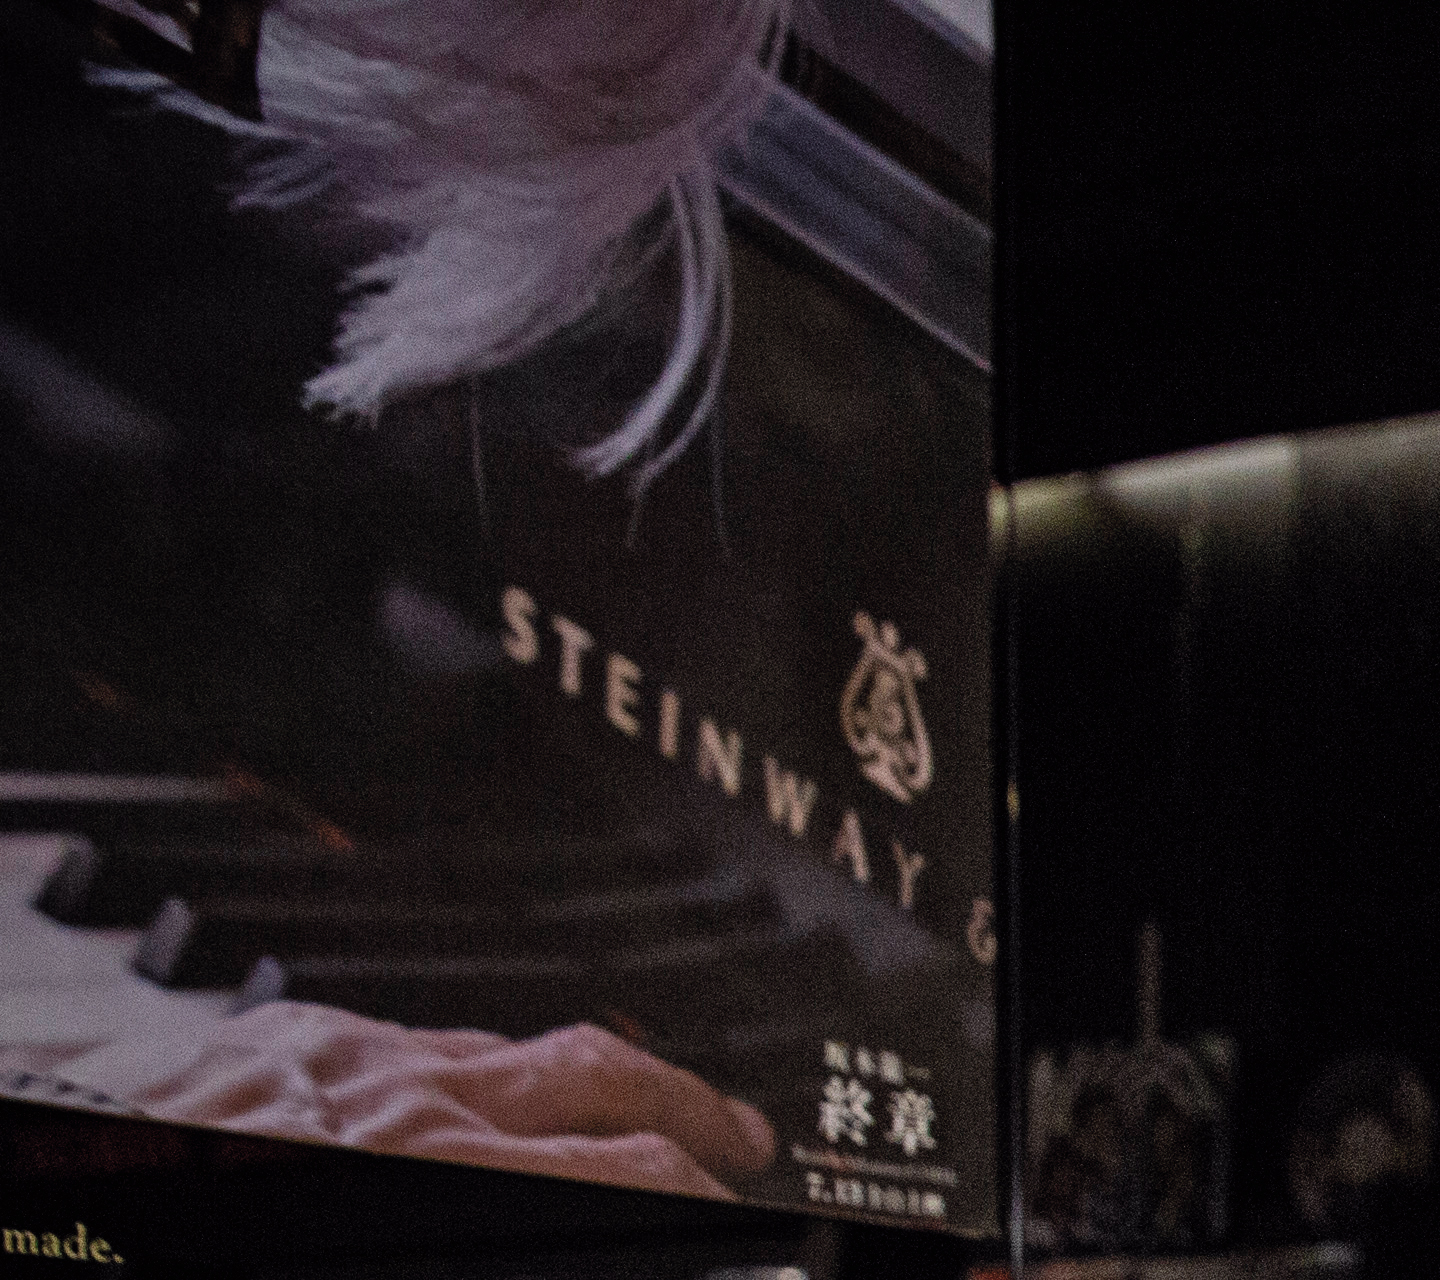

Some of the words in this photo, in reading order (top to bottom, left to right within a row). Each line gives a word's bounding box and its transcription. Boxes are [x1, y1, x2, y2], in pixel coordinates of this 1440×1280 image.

[502, 587, 926, 908] STEINWAY
[818, 1075, 938, 1156] 終章
[2, 1221, 125, 1265] made.
